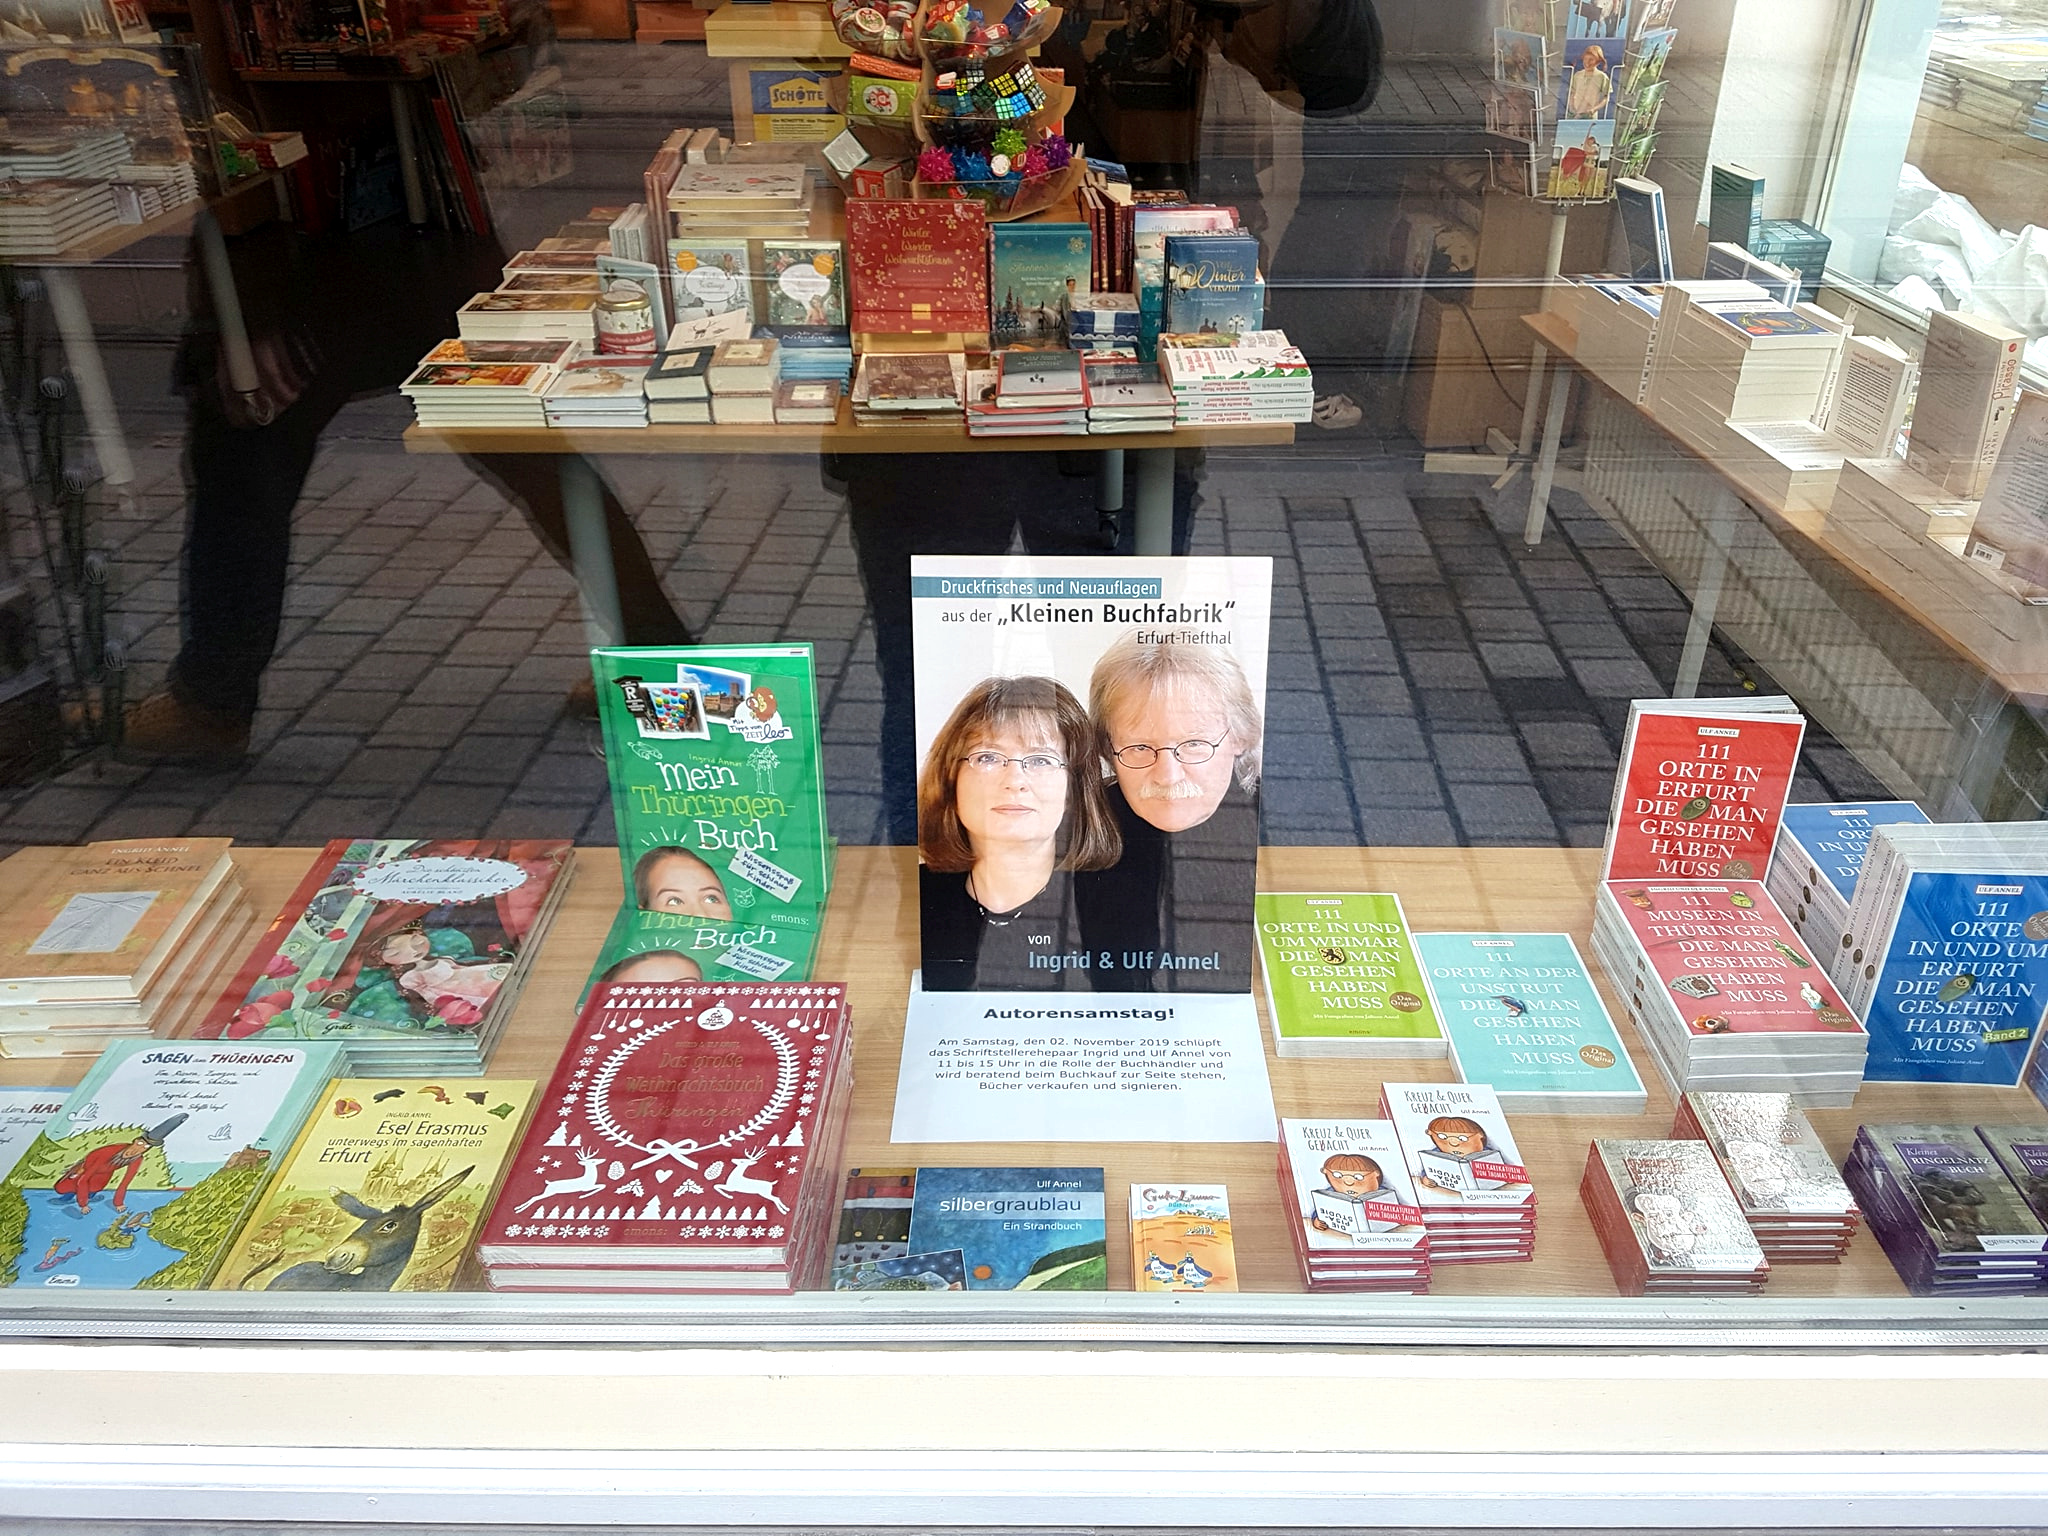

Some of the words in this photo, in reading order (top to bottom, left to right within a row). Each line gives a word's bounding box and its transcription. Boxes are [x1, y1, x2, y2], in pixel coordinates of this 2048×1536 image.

[941, 580, 1033, 595] Druckfrisches
[1038, 580, 1064, 595] und
[1069, 580, 1158, 598] Neuauflagen
[942, 611, 967, 623] aus
[970, 609, 993, 623] der
[997, 603, 1094, 626] „Kleinen
[1103, 601, 1235, 624] Buchfabrik“
[1136, 630, 1232, 645] Erfurt-Tiefthal
[1697, 744, 1730, 760] 111
[655, 762, 738, 792] Mein
[1658, 760, 1726, 780] ORTE
[1733, 765, 1762, 783] IN
[1656, 780, 1755, 803] ERFURT
[632, 785, 796, 827] Thüringen-
[1635, 799, 1679, 816] DIE
[1708, 804, 1768, 824] MAN
[693, 818, 778, 851] Buch
[1639, 819, 1756, 842] GESEHEN
[1650, 839, 1736, 860] HABEN
[741, 859, 757, 872] für
[758, 868, 789, 890] schlaue
[743, 851, 795, 885] Wissensspaß
[1656, 858, 1720, 878] MUSS
[746, 870, 776, 891] Kinder
[1681, 896, 1711, 906] 111
[1314, 909, 1342, 919] 111
[1646, 910, 1735, 922] MUSEEN
[1737, 910, 1764, 922] IN
[1976, 903, 2009, 917] 111
[1263, 922, 1321, 933] ORTE
[1326, 922, 1349, 933] IN
[1353, 923, 1400, 934] UND
[1648, 923, 1781, 937] THÜRINGEN
[1951, 921, 2023, 938] ORTE
[1028, 934, 1051, 945] von
[1270, 937, 1306, 947] UM
[1308, 937, 1402, 948] WEIMAR
[1678, 941, 1719, 952] DIE
[1721, 941, 1773, 952] MAN
[1279, 951, 1318, 962] DIE
[1349, 951, 1401, 962] MAN
[1907, 941, 1939, 957] IN
[1943, 942, 2000, 957] UND
[2007, 943, 2048, 958] UM
[1028, 951, 1091, 972] Ingrid
[1100, 952, 1114, 969] &
[1123, 951, 1153, 969] Ulf
[1159, 952, 1220, 970] Annel
[1683, 957, 1788, 969] GESEHEN
[1291, 966, 1397, 977] GESEHEN
[1433, 967, 1494, 978] ORTE
[1500, 967, 1530, 978] AN
[1534, 967, 1581, 978] DER
[1920, 961, 2025, 978] ERFURT
[1708, 973, 1786, 985] HABEN
[1308, 981, 1388, 993] HABEN
[1460, 983, 1565, 994] UNSTRUT
[1893, 980, 1940, 995] DIE
[1972, 982, 2035, 998] MAN
[1322, 996, 1384, 1009] MUSS
[1725, 990, 1788, 1003] MUSS
[1459, 999, 1500, 1011] DIE
[1527, 999, 1581, 1011] MAN
[1898, 1000, 2019, 1016] GESEHEN
[983, 1008, 1175, 1021] Autorensamstag!
[1905, 1018, 1997, 1034] HABEN
[1984, 1031, 2013, 1041] Band
[2016, 1029, 2027, 1038] 2
[938, 1038, 959, 1046] Am
[962, 1038, 1019, 1048] Samstag,
[1023, 1038, 1046, 1046] den
[1049, 1038, 1069, 1046] 02.
[1074, 1038, 1135, 1046] November
[1139, 1038, 1169, 1046] 2019
[1173, 1038, 1221, 1048] schlüpft
[1910, 1038, 1977, 1053] MUSS
[142, 1053, 194, 1064] SAGEN
[209, 1052, 295, 1064] THÜRINGEN
[929, 1048, 950, 1057] das
[953, 1048, 1079, 1059] Schriftstellerehepaar
[1083, 1048, 1119, 1059] Ingrid
[1123, 1048, 1145, 1057] und
[1150, 1048, 1167, 1057] Ulf
[1170, 1048, 1205, 1057] Annel
[1209, 1048, 1231, 1057] von
[659, 1053, 688, 1069] Das
[691, 1054, 744, 1072] große
[938, 1060, 952, 1068] 11
[957, 1060, 975, 1068] bis
[979, 1060, 994, 1068] 15
[998, 1060, 1020, 1068] Uhr
[1024, 1060, 1035, 1068] in
[1039, 1060, 1058, 1068] die
[1062, 1060, 1091, 1068] Rolle
[1096, 1060, 1116, 1068] der
[1120, 1060, 1197, 1068] Buchhändler
[1201, 1060, 1224, 1068] und
[935, 1070, 961, 1079] wird
[966, 1070, 1021, 1079] beratend
[1025, 1070, 1055, 1079] beim
[1059, 1070, 1117, 1079] Buchkauf
[1121, 1070, 1141, 1079] zur
[1145, 1070, 1175, 1079] Seite
[1177, 1070, 1226, 1081] stehen,
[626, 1076, 765, 1093] Weihnachtsbuch
[979, 1081, 1023, 1090] Bücher
[1027, 1081, 1089, 1090] verkaufen
[1093, 1081, 1117, 1090] und
[1121, 1081, 1182, 1092] signieren.
[376, 1120, 412, 1135] Esel
[415, 1121, 489, 1136] Erasmus
[1302, 1126, 1331, 1139] KREUZ
[1335, 1126, 1344, 1138] &
[1346, 1127, 1372, 1140] QUER
[327, 1138, 389, 1148] unterwegs
[392, 1137, 408, 1146] im
[410, 1138, 483, 1149] sagenhaften
[318, 1148, 372, 1164] Erfurt
[1906, 1147, 1938, 1156] Kleines
[1950, 1166, 1985, 1174] BUCH
[1036, 1180, 1051, 1188] Ulf
[1053, 1180, 1082, 1188] Annel
[939, 1196, 1082, 1214] silbergraublau
[1003, 1222, 1021, 1231] Ein
[1023, 1222, 1082, 1231] Strandbuch
